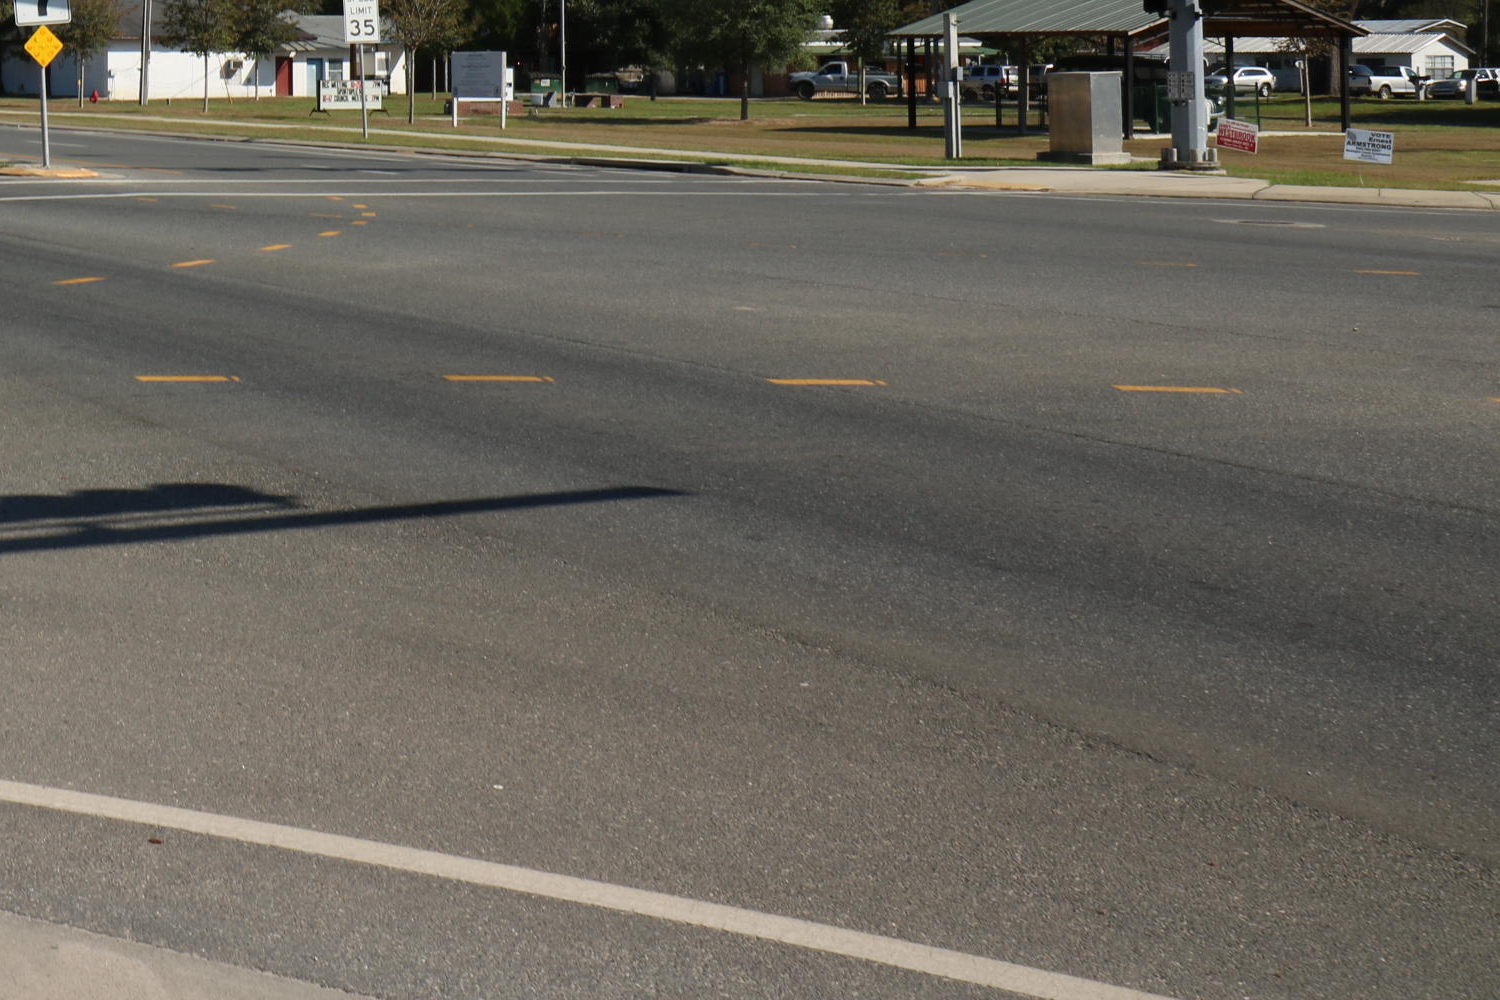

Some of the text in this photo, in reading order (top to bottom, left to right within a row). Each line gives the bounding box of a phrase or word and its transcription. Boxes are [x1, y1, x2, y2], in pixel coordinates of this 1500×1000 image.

[350, 6, 372, 15] LIMIT
[350, 19, 375, 36] 35
[1370, 131, 1391, 139] VOTE
[1346, 140, 1392, 151] ARMSTRONG
